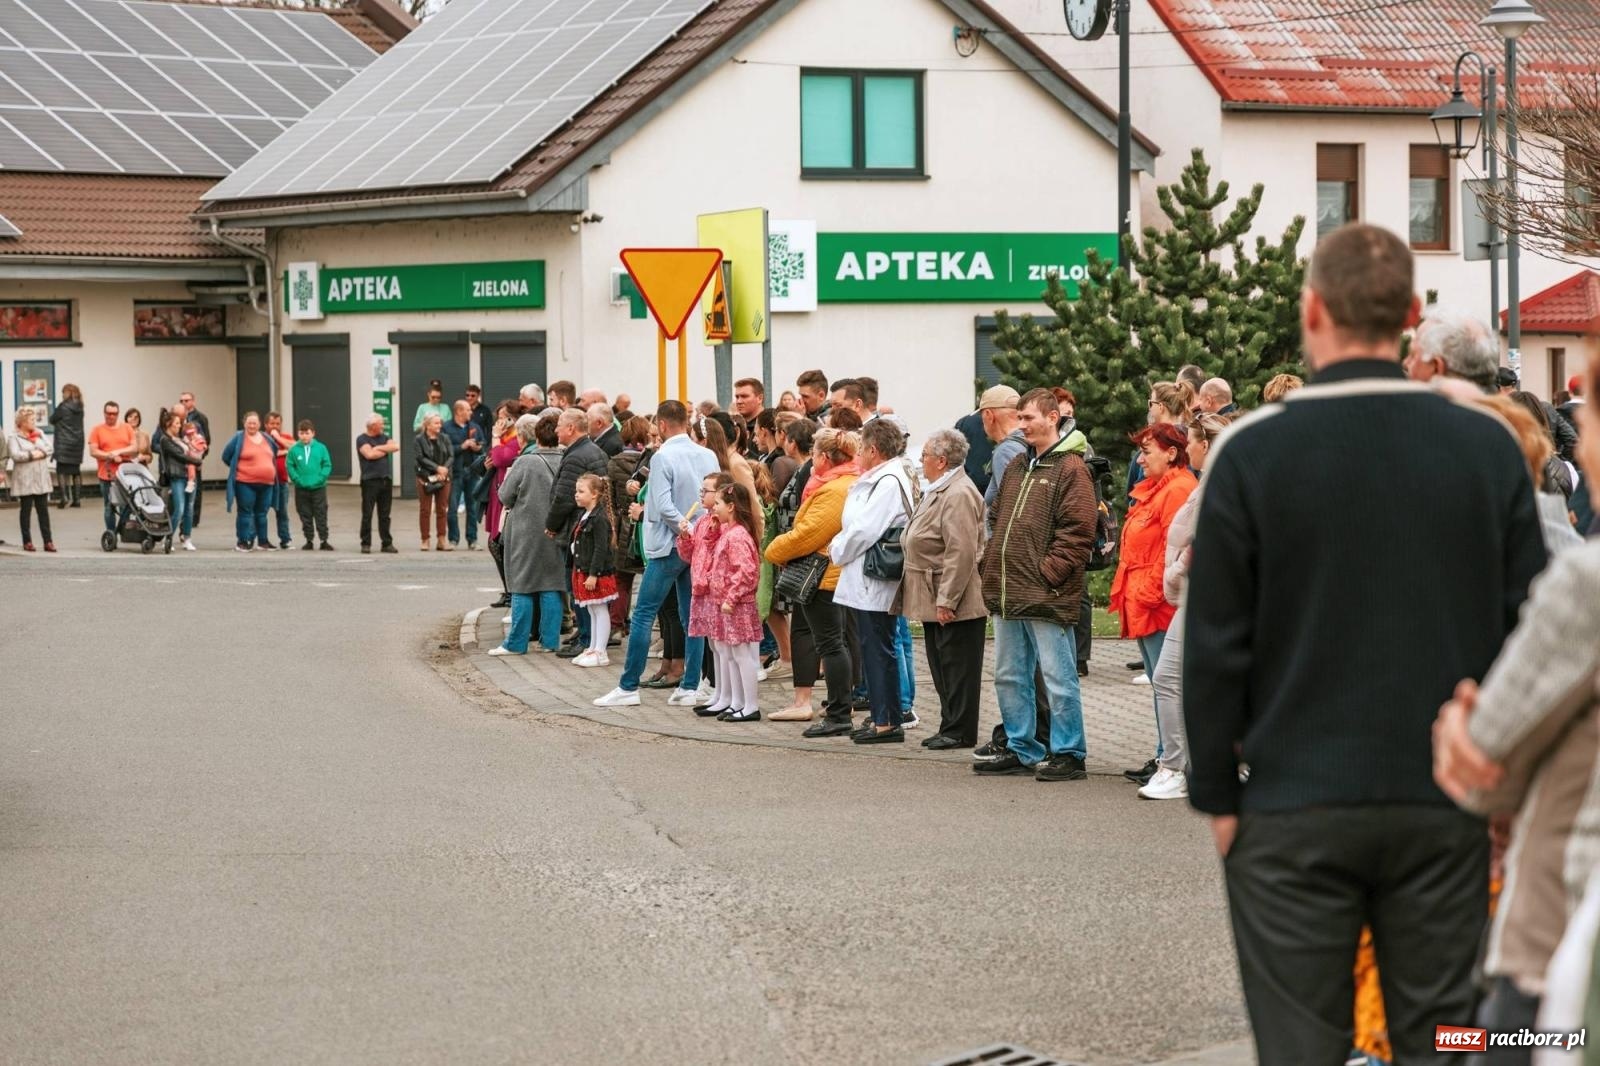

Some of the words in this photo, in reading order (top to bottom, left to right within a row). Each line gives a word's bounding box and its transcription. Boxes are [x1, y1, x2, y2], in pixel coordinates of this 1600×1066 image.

[835, 251, 995, 280] APTEKA
[327, 276, 402, 301] APTEKA
[472, 279, 529, 297] ZIELONA
